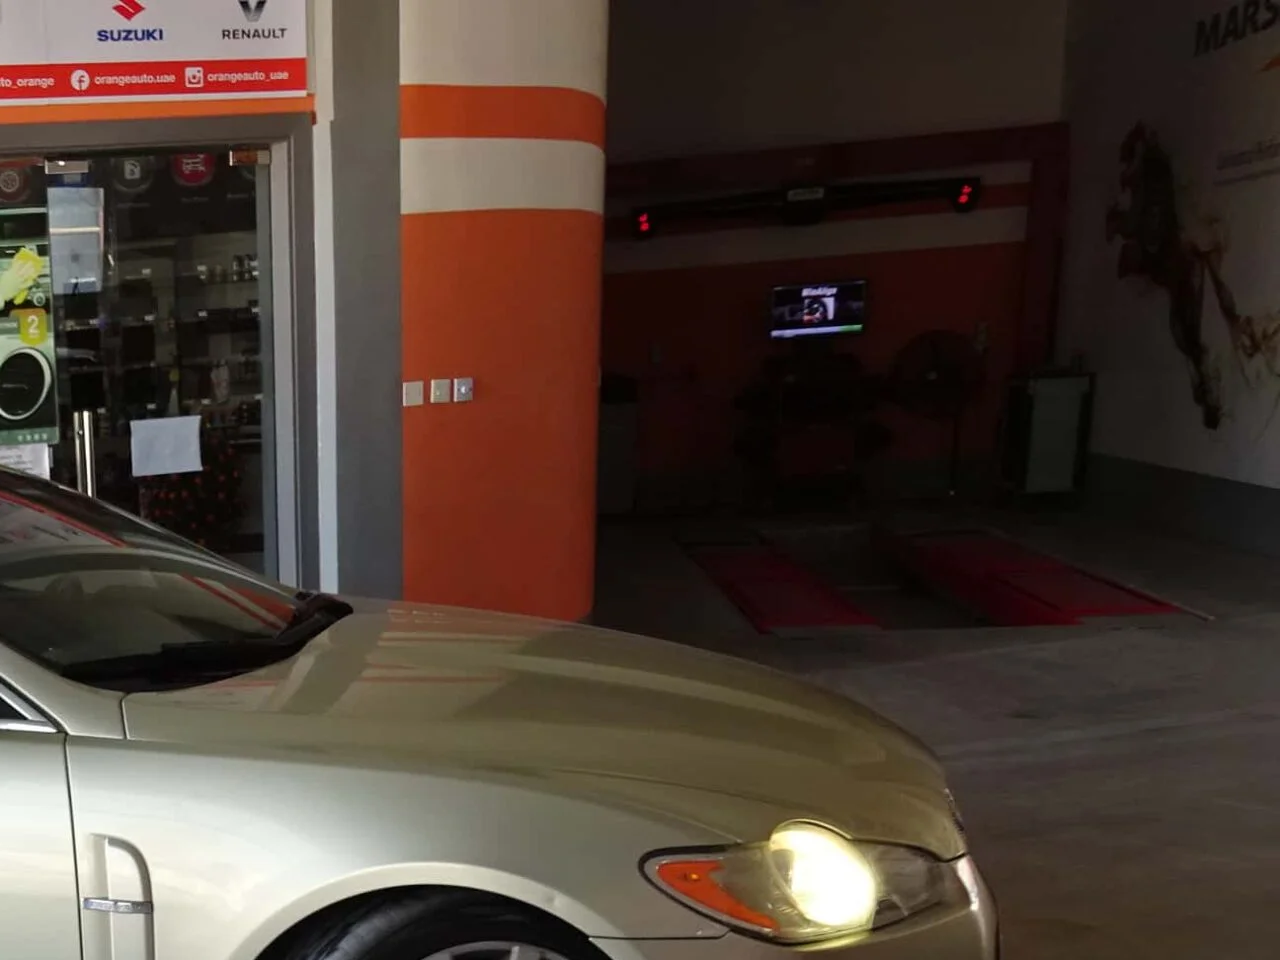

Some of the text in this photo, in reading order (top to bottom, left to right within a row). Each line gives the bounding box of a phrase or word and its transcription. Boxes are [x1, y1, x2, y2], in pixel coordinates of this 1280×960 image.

[97, 29, 163, 42] SUZUKI
[221, 28, 288, 40] RENAULT
[94, 73, 177, 86] orangeauto.uae
[207, 70, 290, 83] orangeauto_uae
[27, 315, 40, 334] 2
